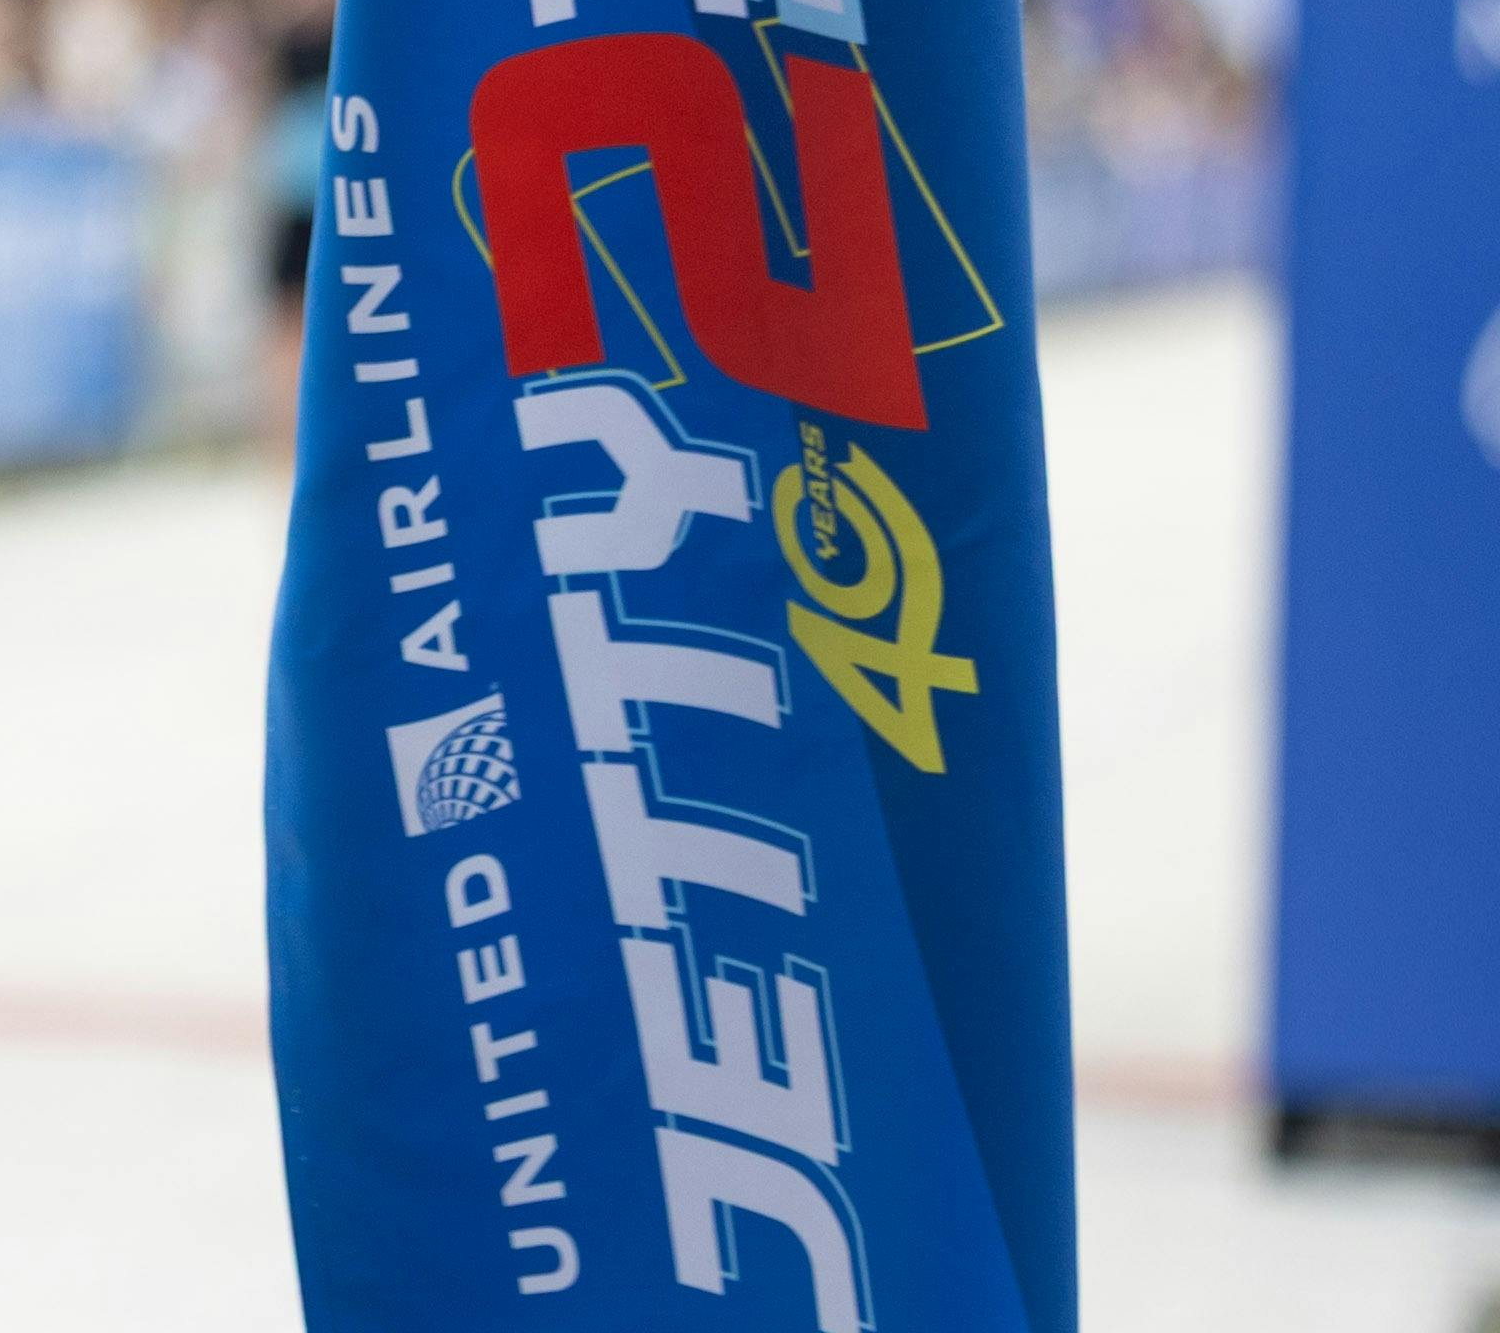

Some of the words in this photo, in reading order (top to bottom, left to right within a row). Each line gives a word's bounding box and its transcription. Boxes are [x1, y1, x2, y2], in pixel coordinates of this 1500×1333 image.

[333, 93, 470, 673] AIRLINES
[469, 30, 928, 431] 2
[800, 420, 840, 561] YEARS
[444, 852, 578, 1296] UNITED
[513, 375, 870, 1333] JETTY
